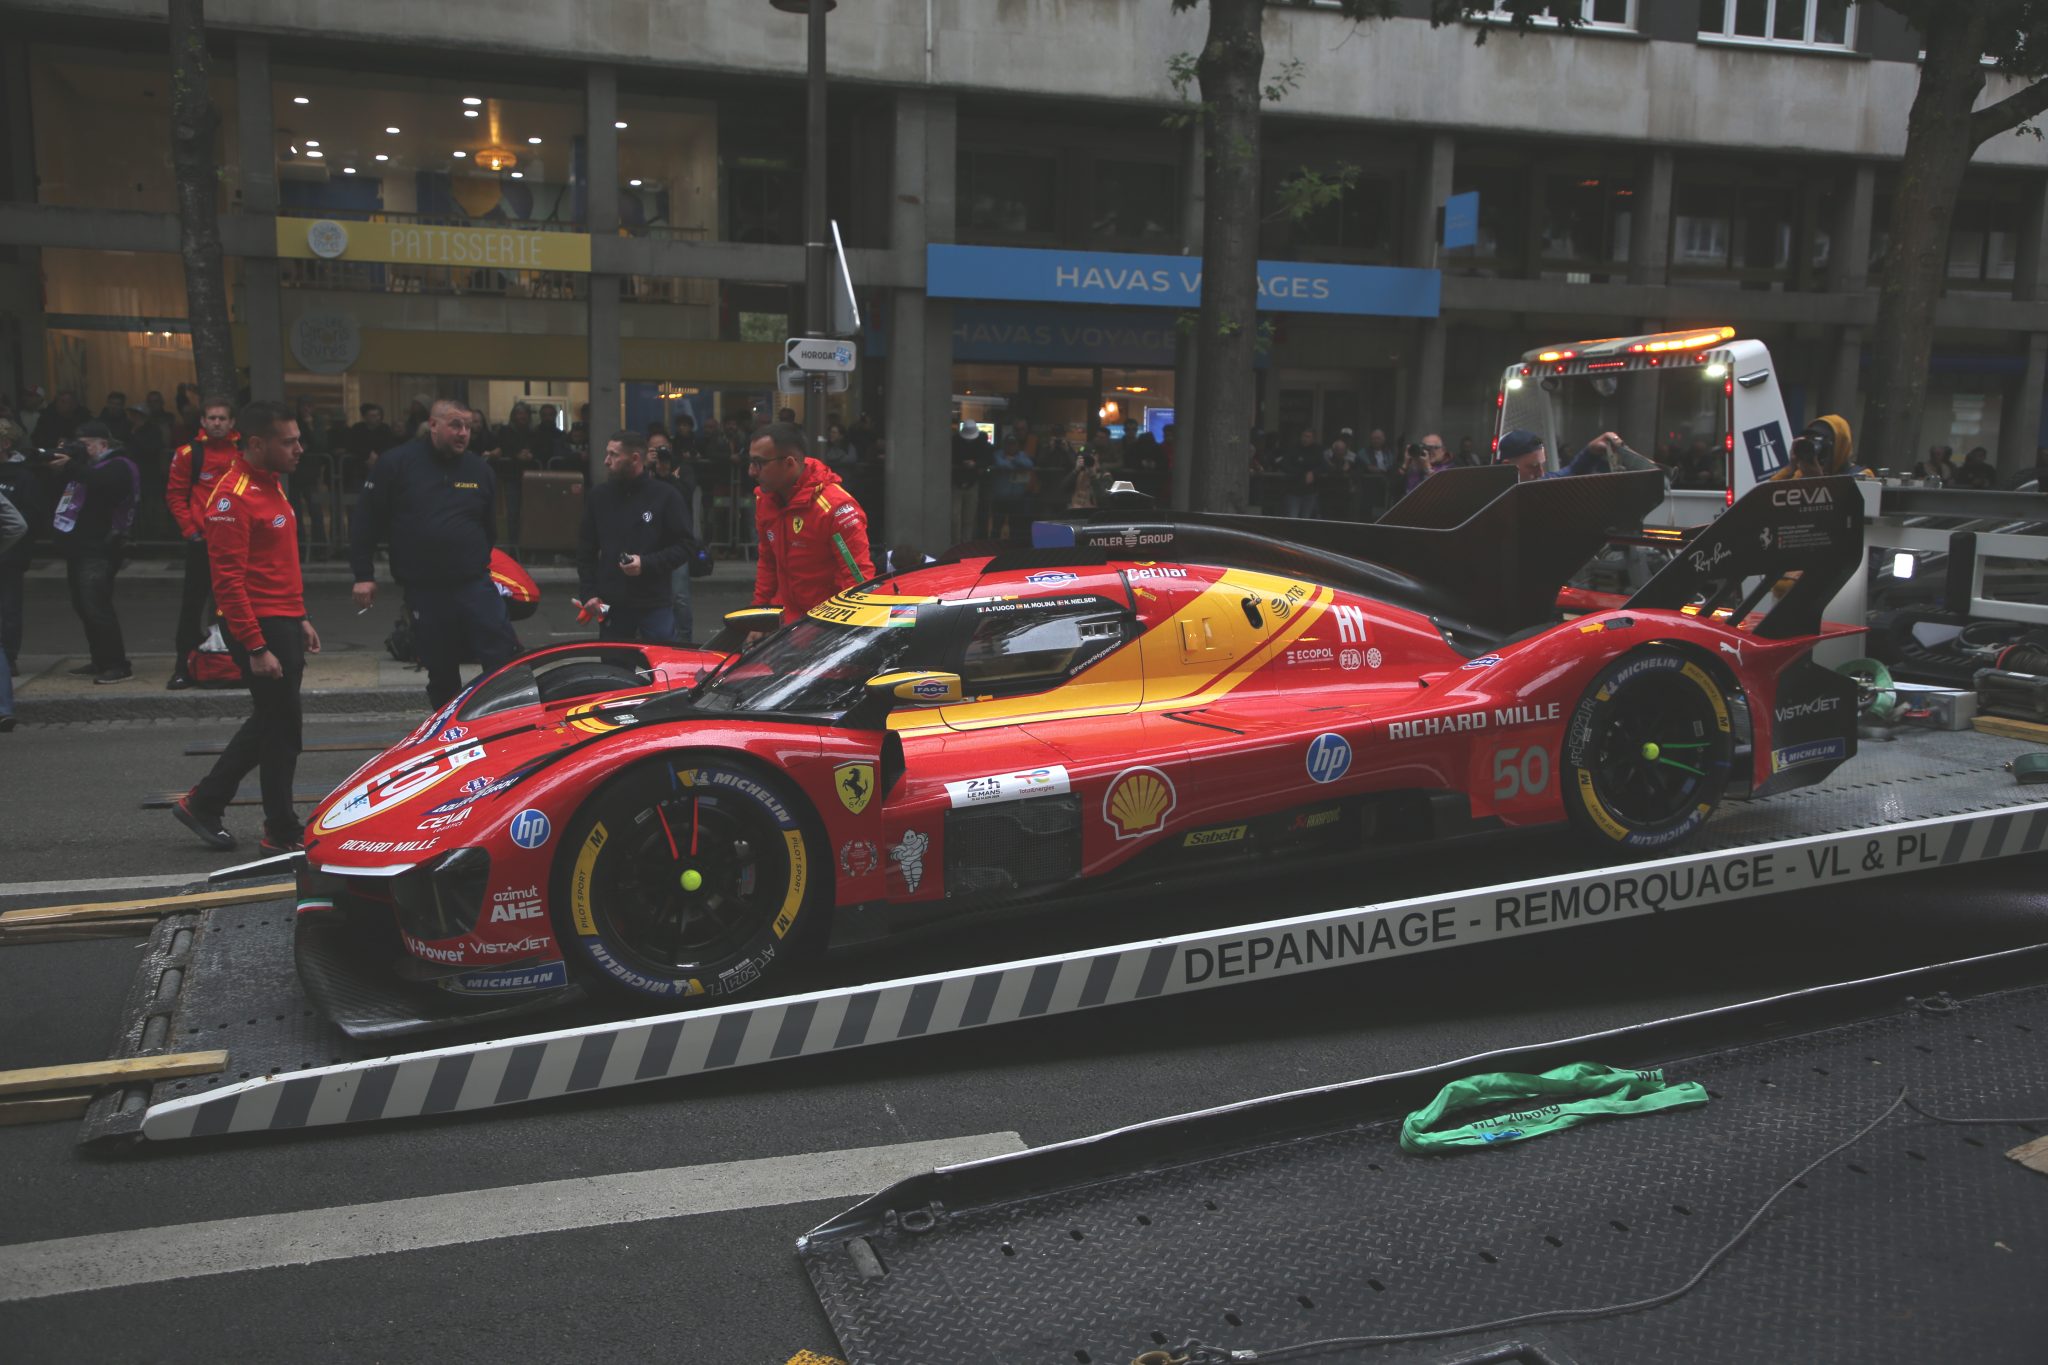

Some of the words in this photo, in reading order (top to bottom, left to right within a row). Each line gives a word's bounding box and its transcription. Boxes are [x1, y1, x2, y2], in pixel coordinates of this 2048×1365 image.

[391, 228, 543, 266] PATISSERIE
[1056, 266, 1171, 292] HAVAS
[1180, 272, 1329, 298] VAGES
[1089, 537, 1123, 547] ADLER
[1139, 533, 1174, 545] GROUP
[1126, 568, 1188, 581] Cetilar
[1331, 604, 1366, 643] HY
[1296, 648, 1334, 660] ECOPOL
[1616, 658, 1679, 682] MICHELIN
[1388, 711, 1487, 740] RICHARD
[1495, 702, 1560, 726] MILLE
[1313, 735, 1346, 782] hp
[1788, 745, 1836, 762] MICHELIN
[1493, 745, 1549, 800] 50
[713, 774, 791, 824] MICHELIN
[978, 789, 1001, 797] MANS
[517, 810, 545, 848] hp
[590, 828, 604, 848] M
[1190, 827, 1239, 845] Sabelt
[1629, 822, 1691, 846] MICHELIN
[338, 839, 391, 853] RICHARD
[391, 836, 441, 852] MILLE
[791, 836, 802, 861] PILOT
[577, 869, 587, 902] SPORT
[794, 863, 802, 893] SPORT
[493, 885, 539, 902] azimut
[490, 899, 544, 923] AHE
[578, 903, 590, 928] PILOT
[1184, 907, 1456, 985] DEPANNAGE
[1495, 854, 1776, 932] REMORQUAGE
[1808, 845, 1852, 880] VL
[1862, 840, 1884, 871] &
[1897, 831, 1940, 866] PL
[776, 913, 791, 932] M
[466, 972, 553, 988] MICHELIN
[589, 944, 670, 993] MICHELIN
